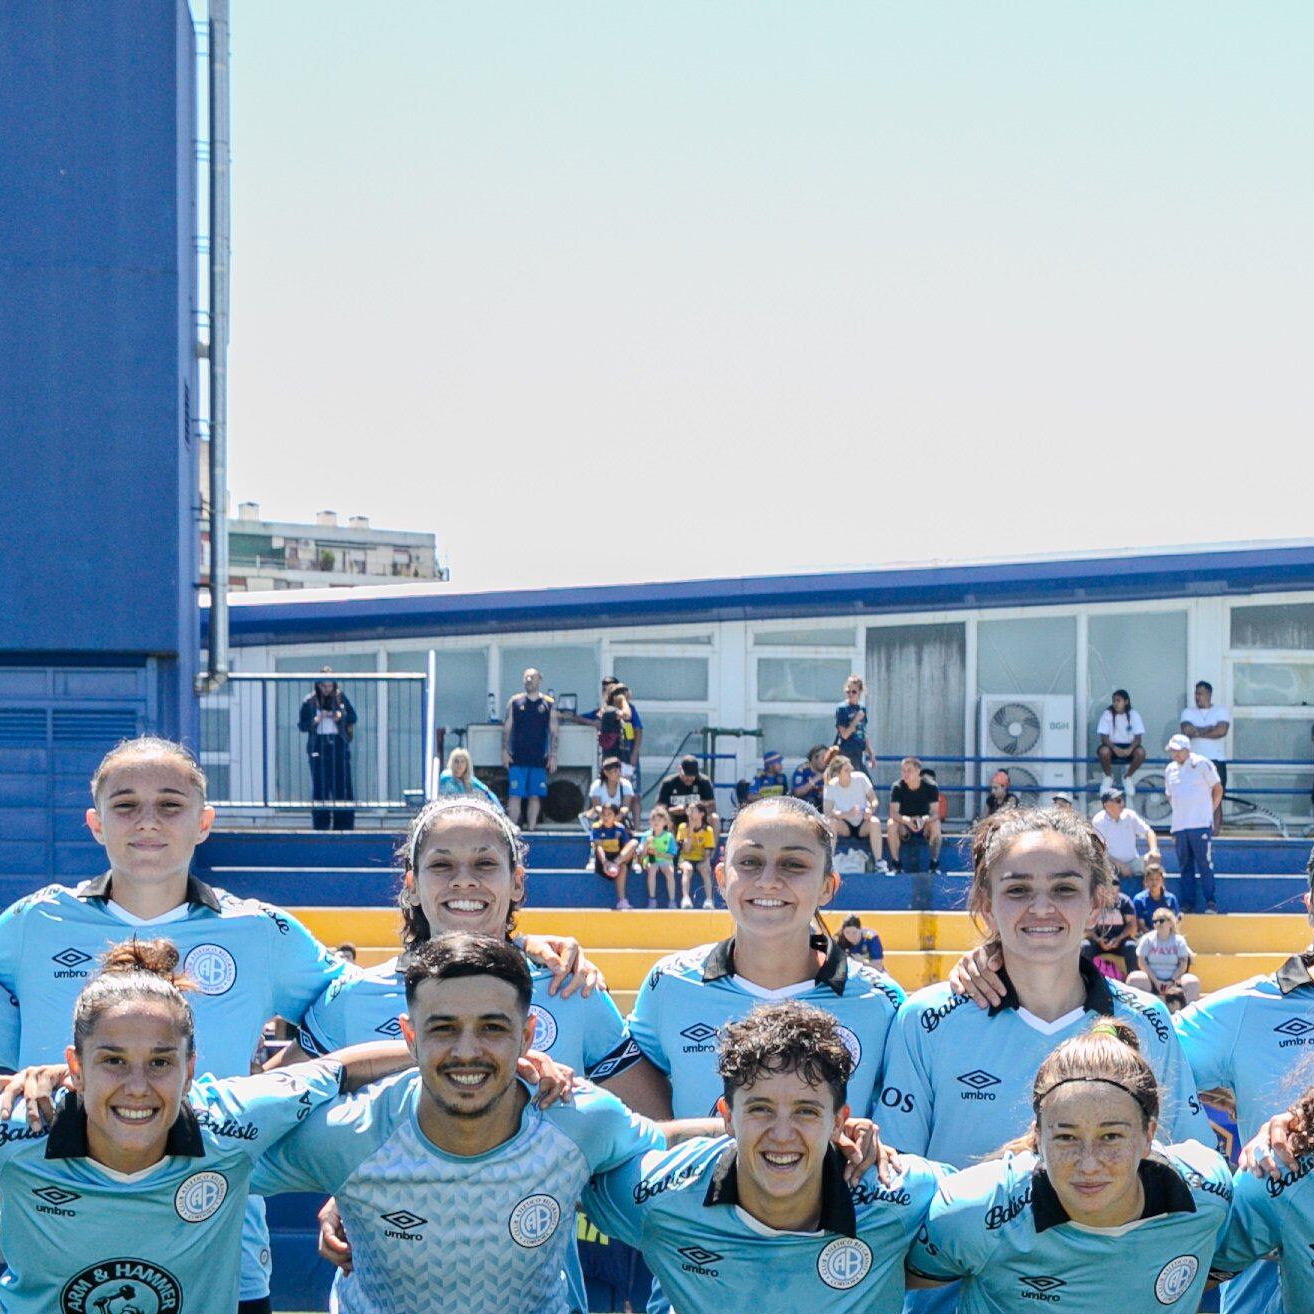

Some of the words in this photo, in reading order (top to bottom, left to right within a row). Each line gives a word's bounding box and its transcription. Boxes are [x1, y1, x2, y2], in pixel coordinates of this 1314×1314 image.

[54, 970, 87, 978] umbro
[682, 1044, 715, 1053] umbro
[961, 1091, 996, 1101] umbro
[36, 1203, 76, 1218] umbro
[384, 1229, 423, 1242] umbro
[681, 1263, 719, 1277] umbro
[68, 1278, 91, 1312] ARM
[93, 1268, 109, 1283] &
[115, 1263, 176, 1310] HAMMER
[1021, 1290, 1060, 1302] umbro
